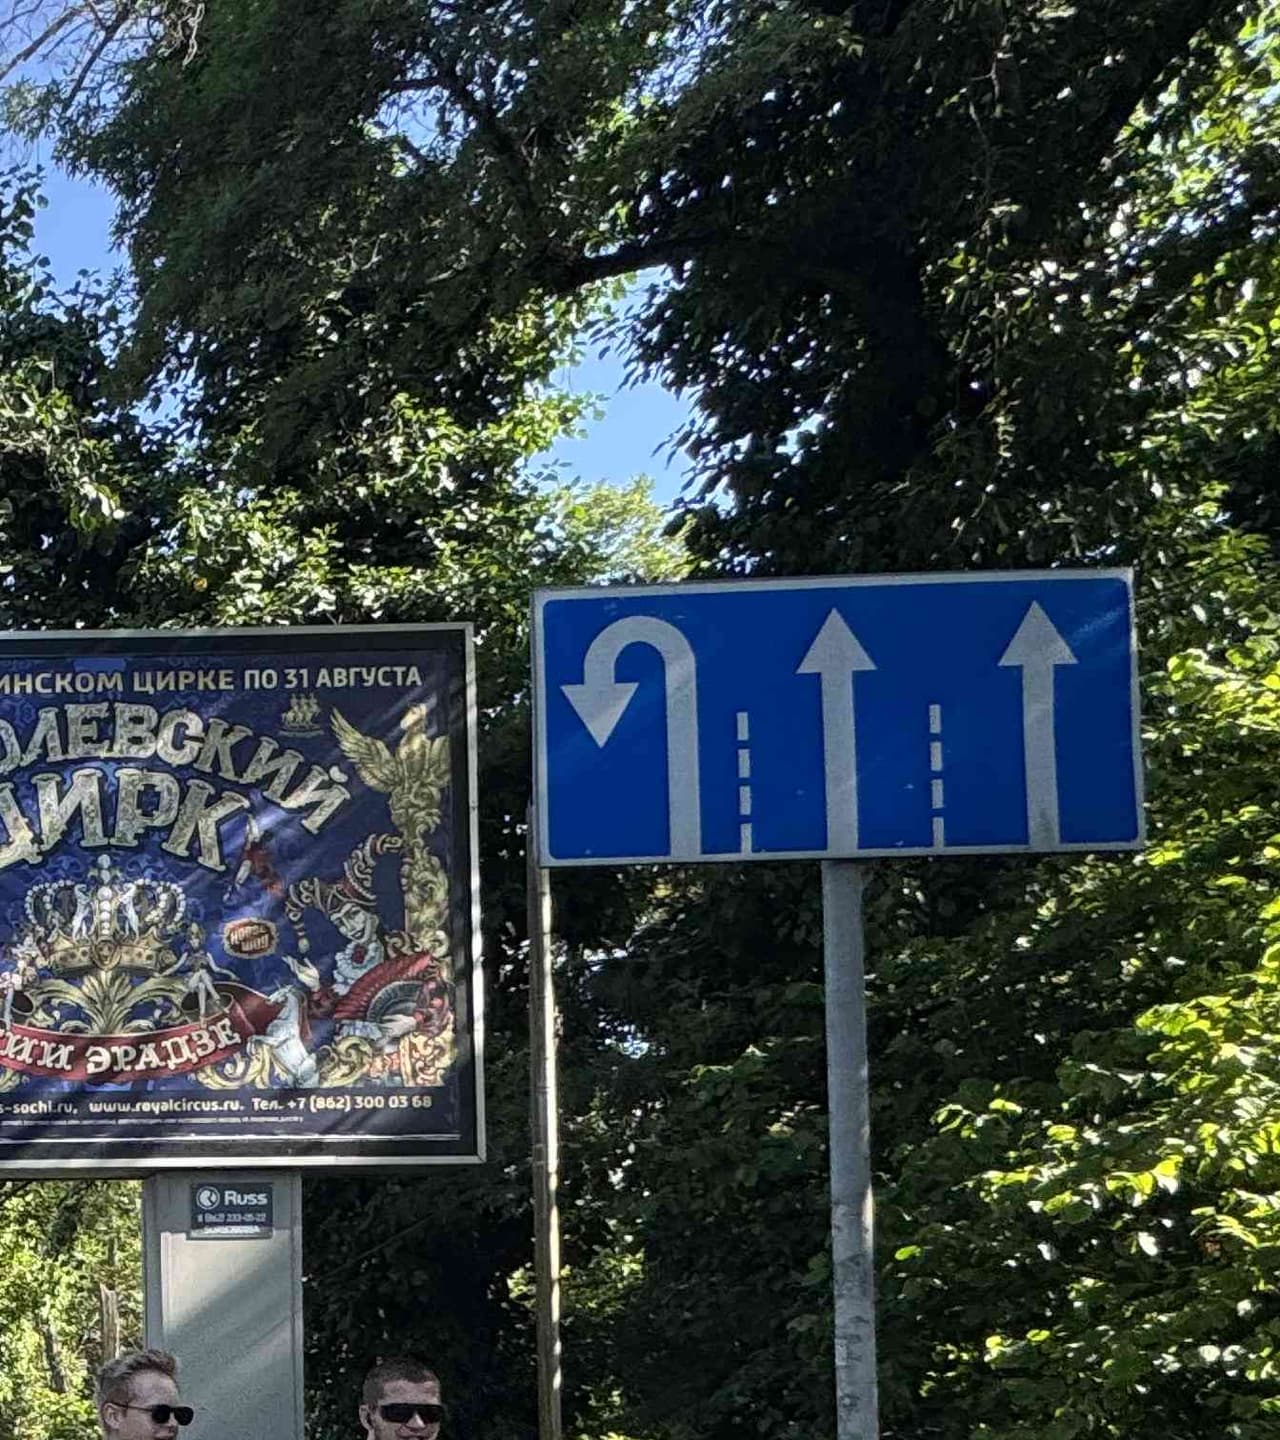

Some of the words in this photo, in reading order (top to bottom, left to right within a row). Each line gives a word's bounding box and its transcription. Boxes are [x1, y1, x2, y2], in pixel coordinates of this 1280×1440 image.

[133, 670, 235, 695] ЦИРКЕ
[244, 669, 278, 690] ПО
[285, 668, 309, 689] 31
[316, 667, 422, 688] АВГУСТА
[85, 1018, 241, 1074] ЭРАДЗЕ
[251, 1096, 284, 1112] Тел.
[286, 1096, 305, 1111] +7
[309, 1093, 351, 1112] (862)
[354, 1094, 385, 1110] 300
[388, 1094, 408, 1109] 03
[411, 1093, 433, 1109] 68
[223, 1190, 268, 1206] Russ
